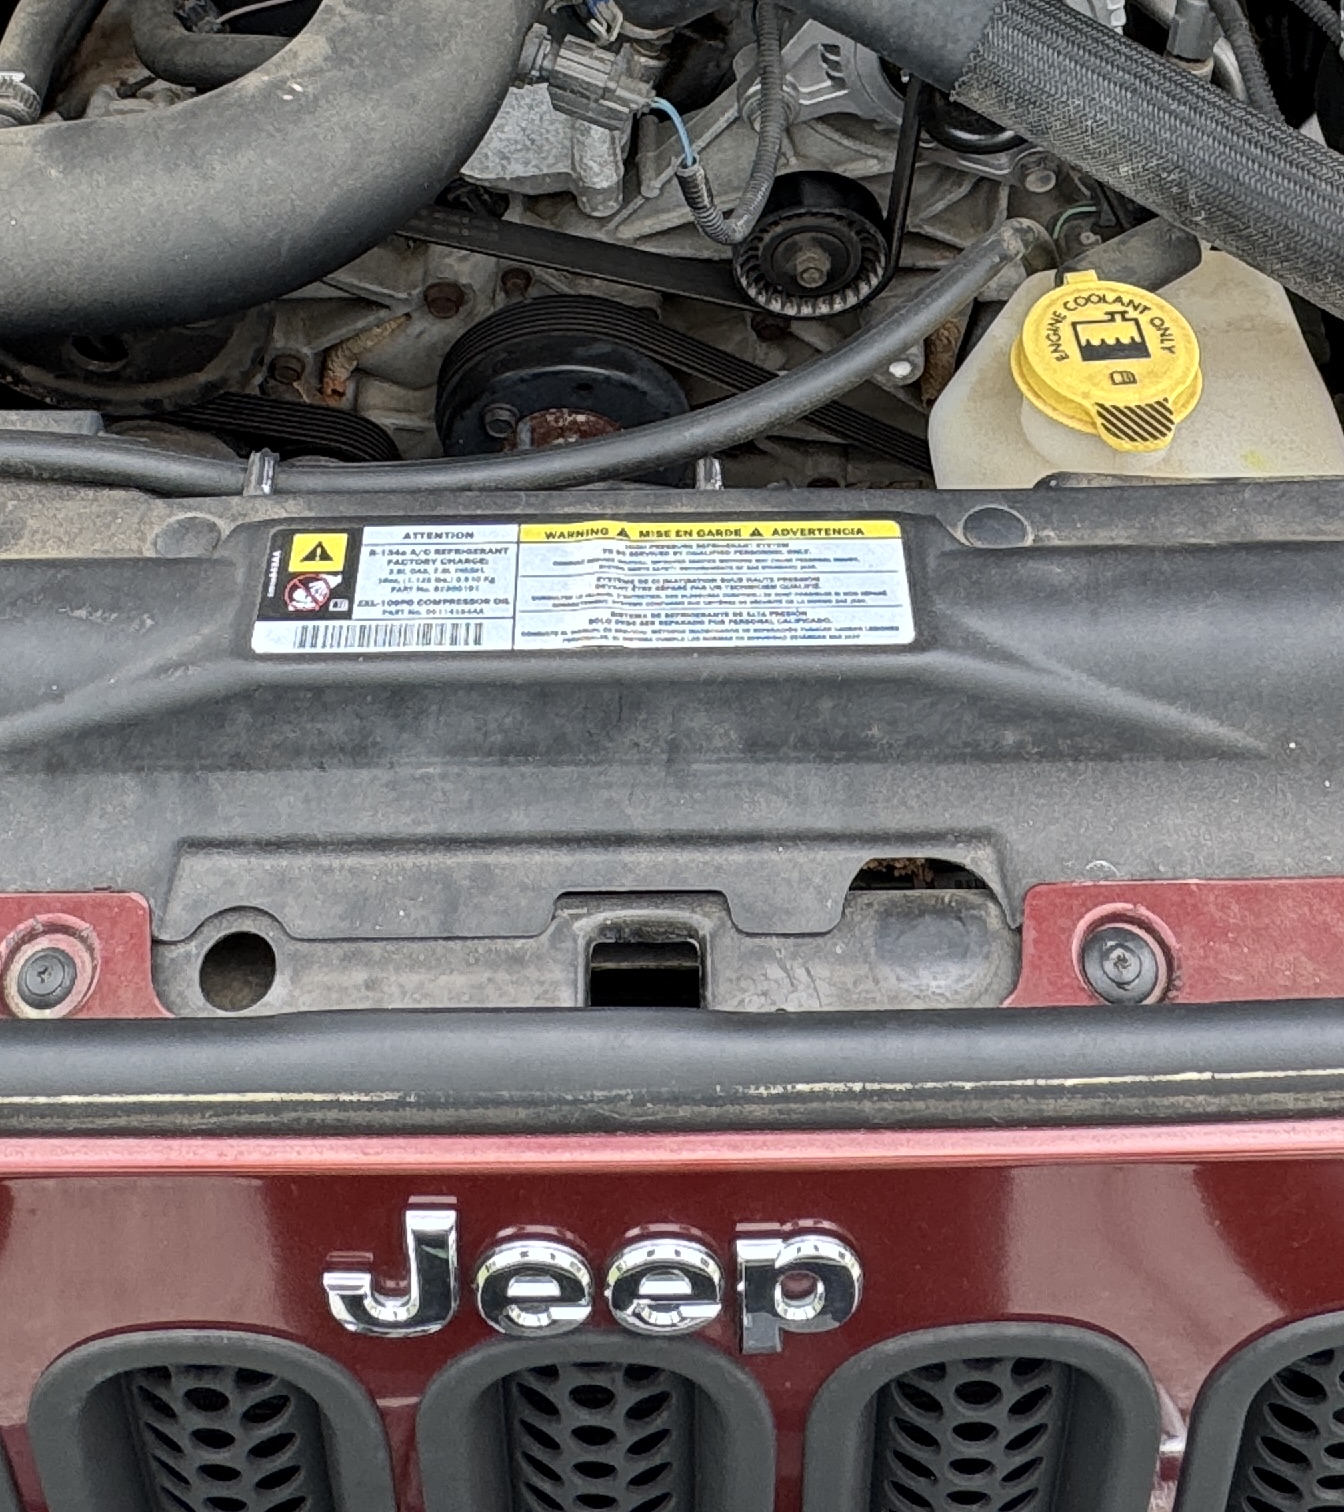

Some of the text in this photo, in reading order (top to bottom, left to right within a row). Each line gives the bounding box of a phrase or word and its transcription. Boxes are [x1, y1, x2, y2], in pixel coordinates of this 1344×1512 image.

[1046, 292, 1177, 363] ENGINE COOLANT ONLY
[402, 531, 474, 540] ATTENTION
[544, 527, 865, 540] WARNING MISE EN GARDE ADVERTENCIA
[322, 1208, 863, 1355] Jeep
